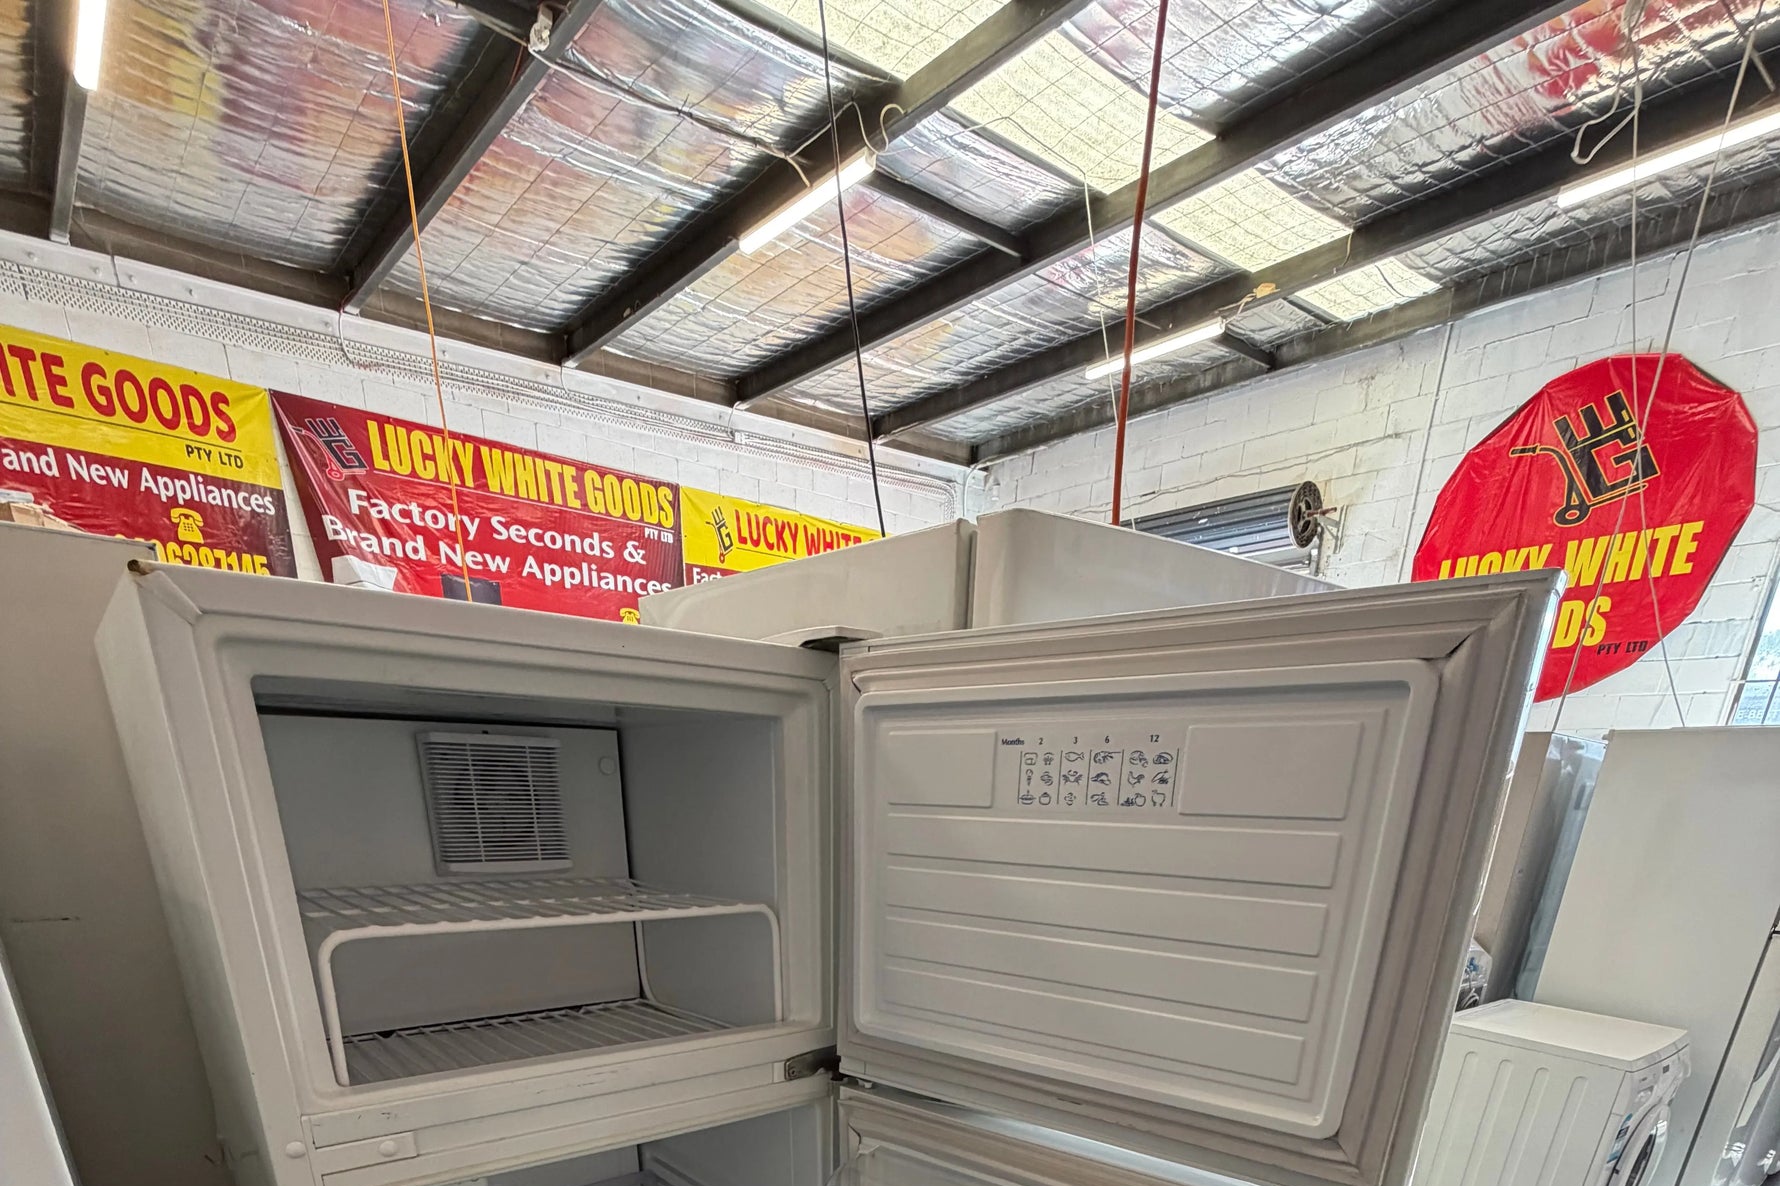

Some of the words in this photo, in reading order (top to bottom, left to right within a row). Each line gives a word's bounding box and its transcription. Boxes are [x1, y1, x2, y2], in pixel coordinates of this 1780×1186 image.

[0, 342, 75, 409] ITE
[81, 361, 237, 443] GOODS
[1, 448, 60, 478] and
[66, 453, 129, 490] New
[140, 466, 275, 516] Appliances
[185, 444, 212, 463] PTY
[219, 450, 244, 470] LTD
[366, 419, 475, 488] LUCKY
[479, 445, 580, 510] WHITE
[584, 469, 675, 529] GOODS
[322, 514, 427, 561] Brand
[440, 541, 511, 574] New
[523, 559, 673, 596] Appliances
[348, 488, 481, 541] Factory
[491, 515, 613, 559] Seconds
[623, 540, 647, 565] &
[644, 527, 659, 541] PTY
[660, 530, 674, 544] LTD
[734, 509, 799, 556] LUCKY
[1564, 521, 1704, 589] WHITE
[1597, 642, 1621, 656] PTY
[1626, 640, 1649, 653] LTD
[1149, 734, 1160, 743] 12
